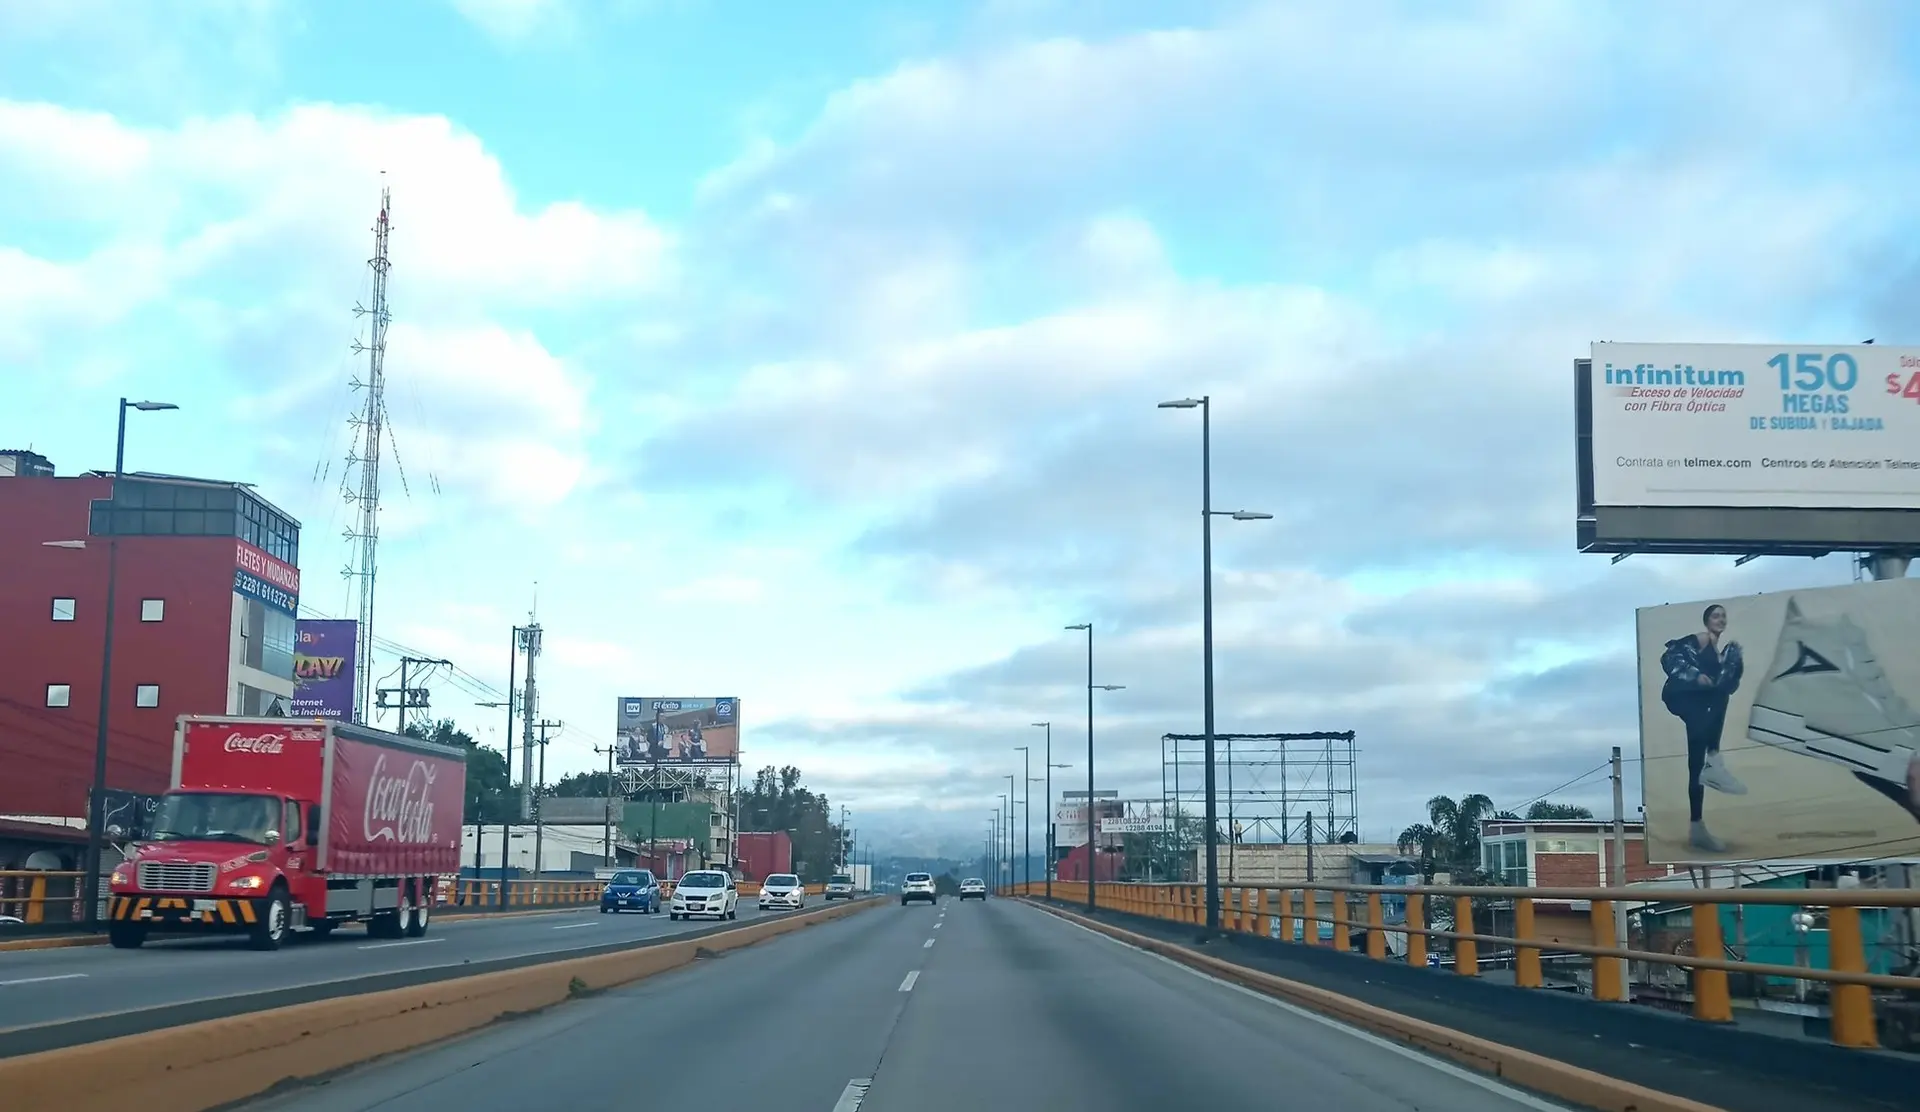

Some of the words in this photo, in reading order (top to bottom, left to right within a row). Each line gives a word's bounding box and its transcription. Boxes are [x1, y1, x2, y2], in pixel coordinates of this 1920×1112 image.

[1605, 364, 1745, 385] infinitum
[1767, 353, 1858, 391] 150
[1631, 387, 1671, 398] Exceso
[1673, 388, 1687, 398] de
[1690, 388, 1744, 398] Velocidad
[1624, 402, 1647, 411] con
[1650, 401, 1682, 412] Fibra
[1686, 399, 1726, 413] Óptica
[1783, 394, 1850, 413] MEGAS
[1750, 417, 1767, 430] DE
[1770, 417, 1817, 430] SUBIDA
[1831, 418, 1884, 430] BAJADA
[1616, 456, 1663, 467] Contrata
[1667, 459, 1680, 467] en
[1684, 457, 1752, 468] telmex.com
[1761, 457, 1807, 468] Centros
[1811, 458, 1826, 468] de
[236, 544, 260, 572] FLETES
[261, 557, 267, 574] Y
[266, 560, 299, 591] MUDANZAS
[242, 575, 260, 595] 2281
[261, 583, 288, 608] 611372
[294, 656, 344, 677] LAY!
[301, 708, 341, 716] incluidas
